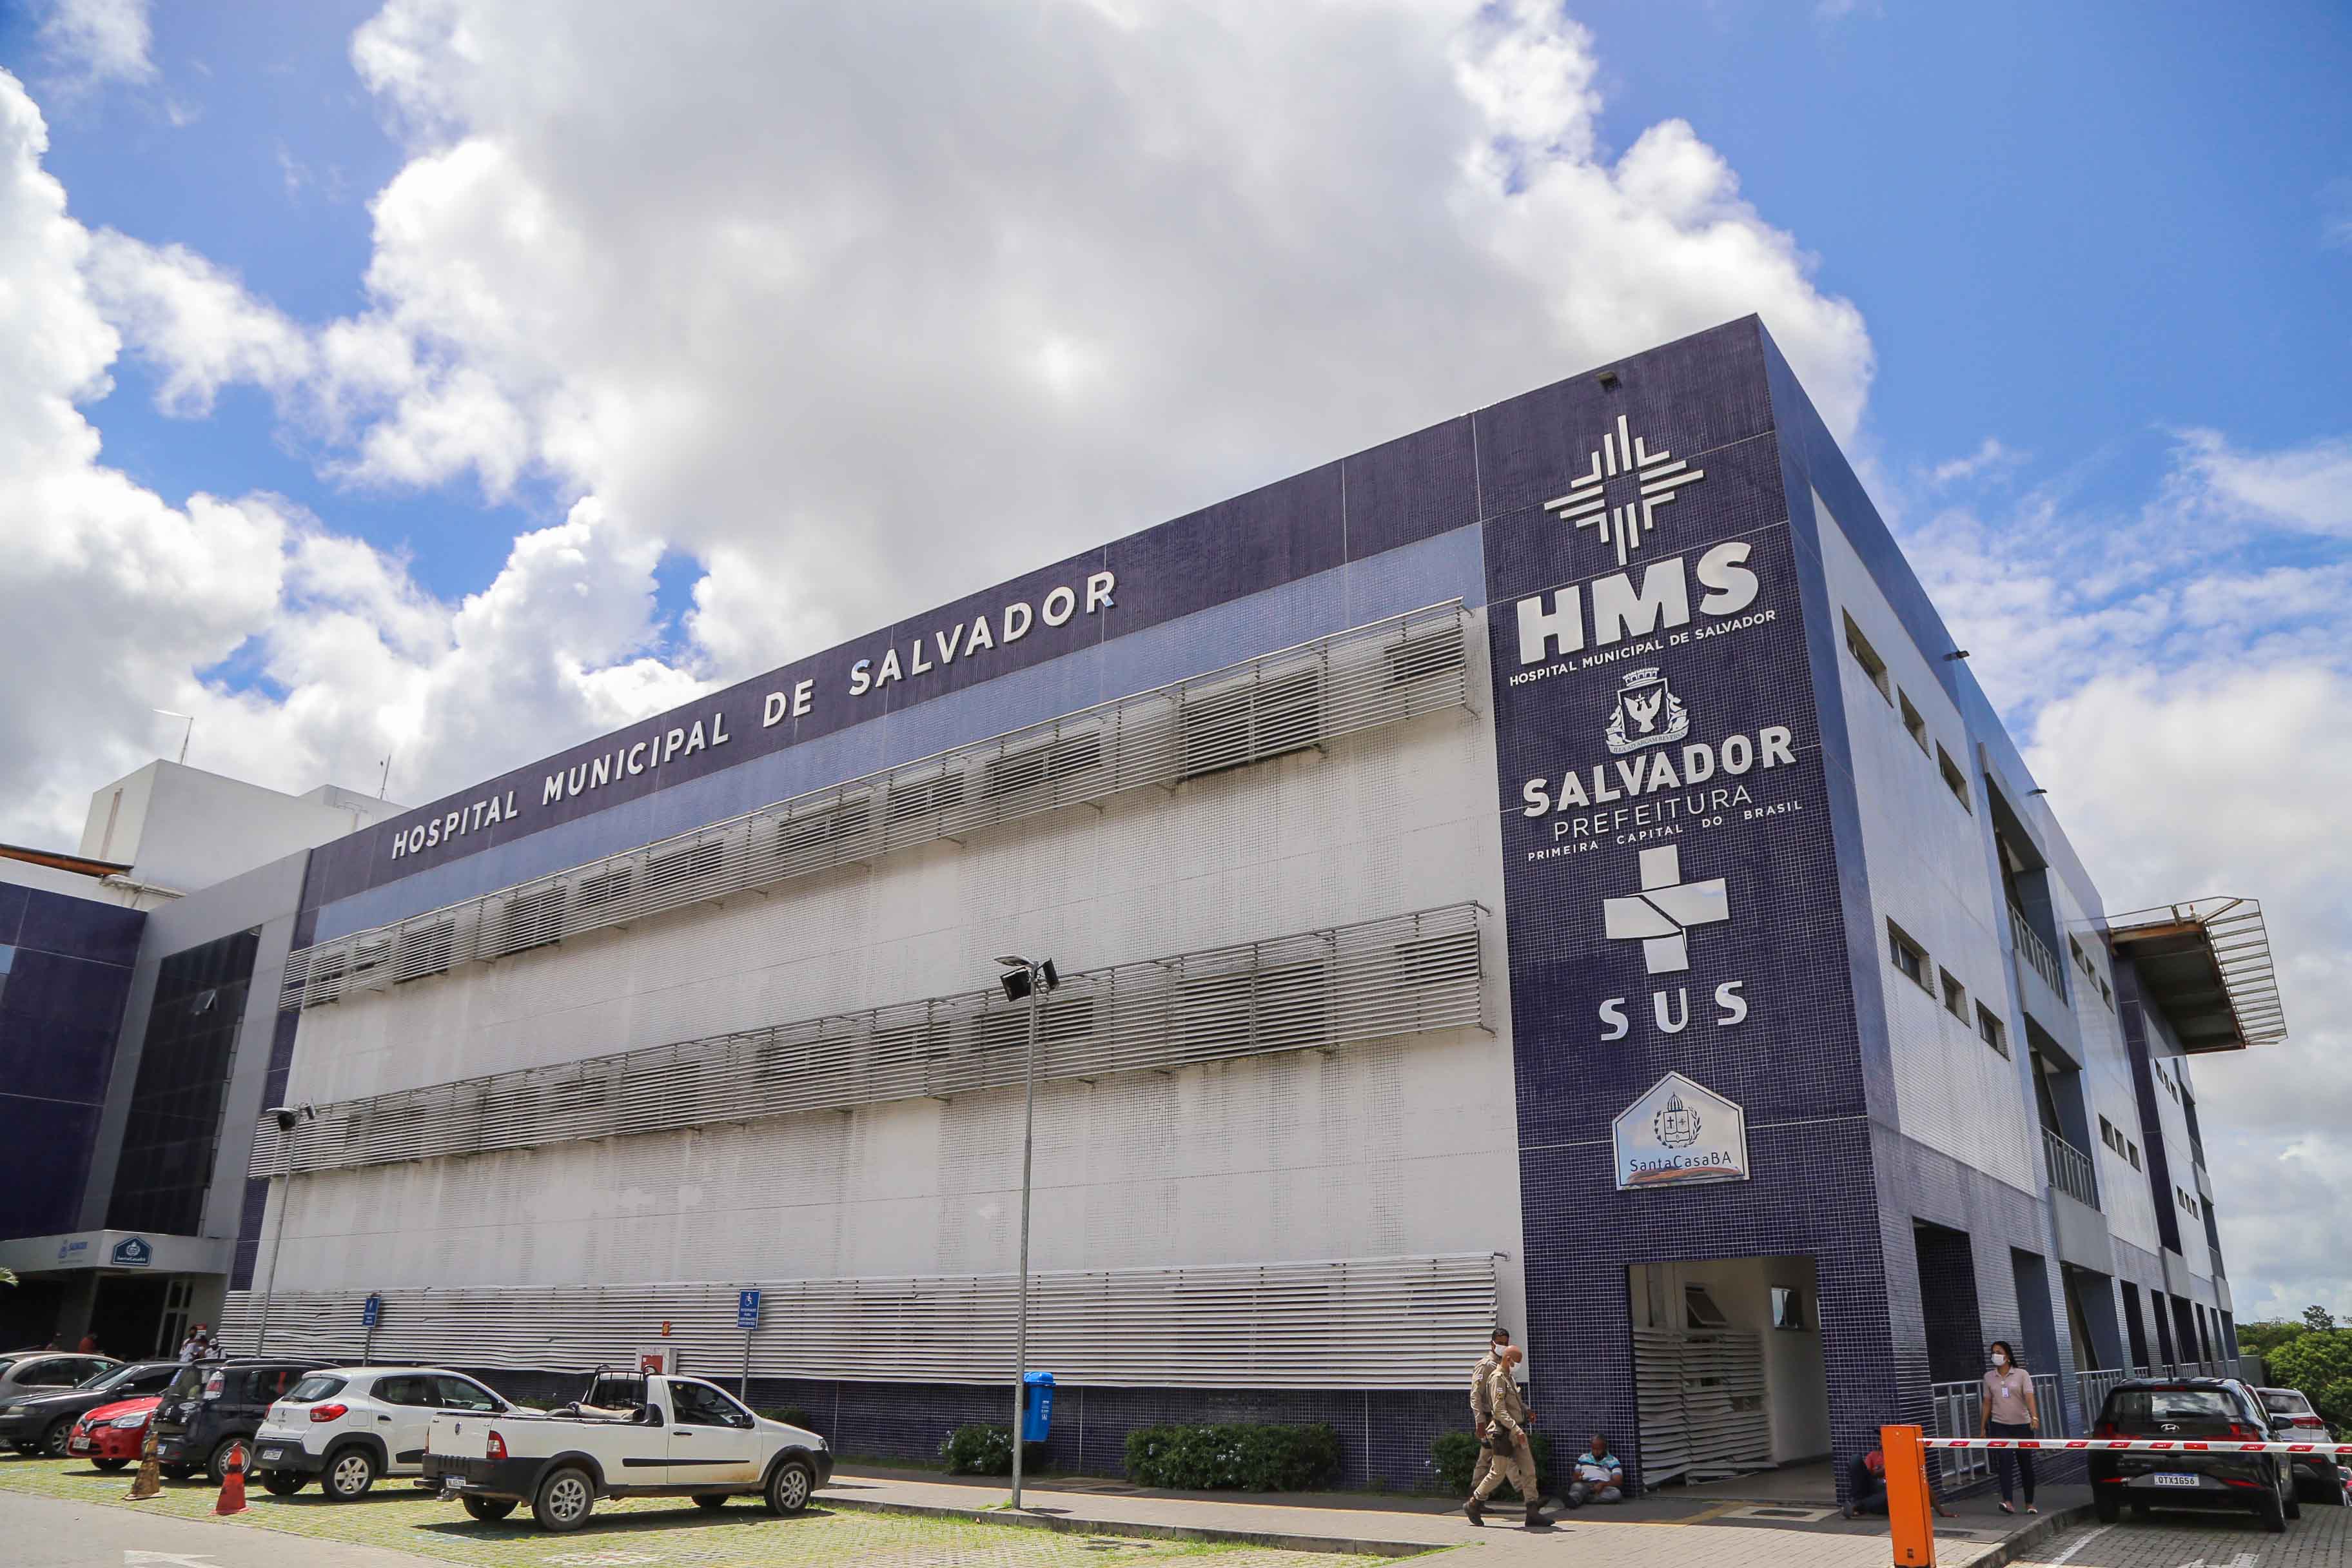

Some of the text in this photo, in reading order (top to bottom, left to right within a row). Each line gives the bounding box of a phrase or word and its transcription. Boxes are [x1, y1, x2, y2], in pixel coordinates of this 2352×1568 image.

[1516, 542, 1759, 665] HMS
[1509, 610, 1776, 687] HOSPITAL MUNICIPAL DE SALVADOR
[391, 571, 1115, 859] HOSPITAL MUNICIPAL DE SALVADOR
[1523, 726, 1797, 817] SALVADOR
[1528, 801, 1803, 861] PRIMEIRA CAPITAL DO BRASIL
[1554, 785, 1752, 841] PREFEITURA
[1599, 981, 1747, 1041] SUS
[1630, 1151, 1732, 1172] SantaCasaBA
